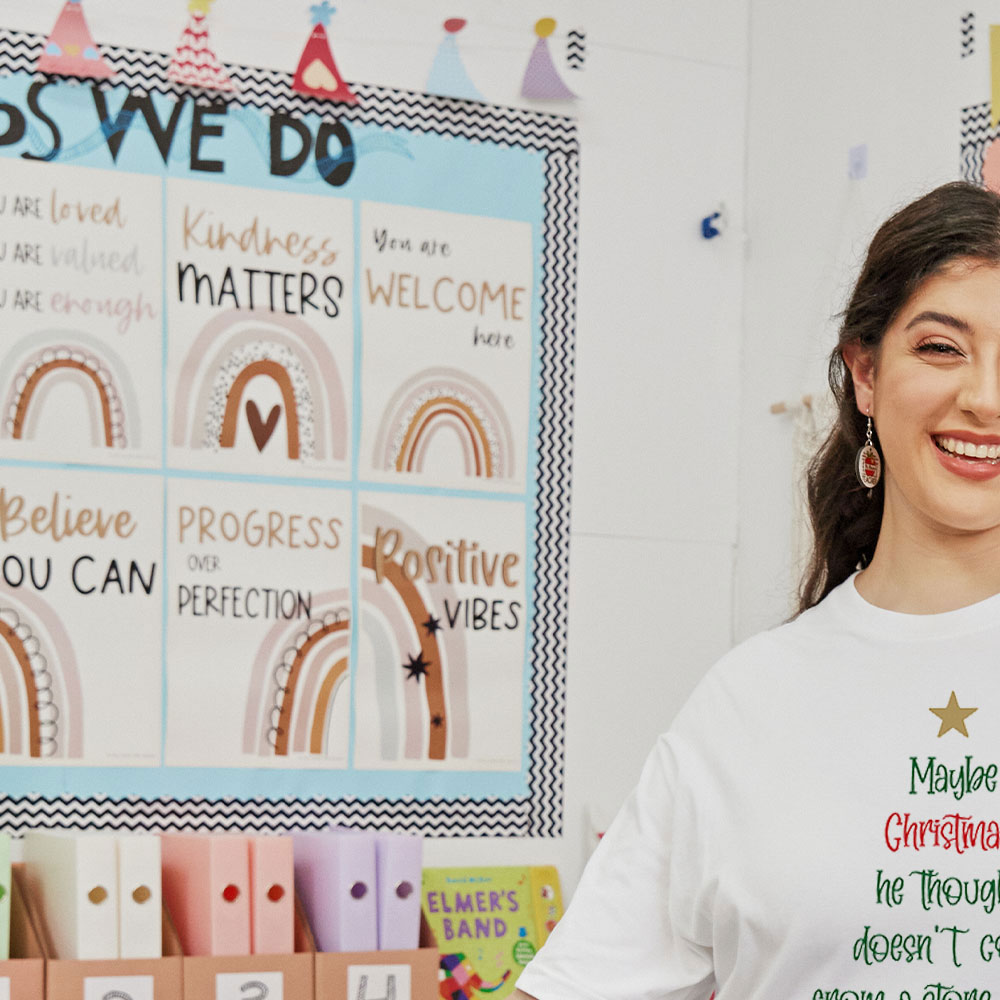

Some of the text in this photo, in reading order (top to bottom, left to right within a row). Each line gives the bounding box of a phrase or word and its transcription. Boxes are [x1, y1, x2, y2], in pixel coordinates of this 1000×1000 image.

[89, 83, 230, 173] WE
[269, 111, 356, 187] DO
[13, 195, 42, 219] ARE
[50, 187, 126, 229] loved
[182, 204, 339, 267] Kindness
[373, 227, 452, 257] You are
[13, 242, 42, 266] ARE
[50, 236, 143, 276] valued
[13, 289, 42, 313] ARE
[50, 290, 157, 336] enough
[366, 270, 526, 321] WELCOME
[472, 325, 516, 350] here
[0, 486, 138, 543] Believe
[179, 505, 343, 549] PROGRESS
[71, 555, 156, 595] CAN
[187, 554, 221, 572] OVER
[374, 526, 521, 588] Positive
[178, 585, 312, 620] PERFECTION
[443, 598, 522, 631] VIBES
[908, 755, 999, 801] Maybe
[427, 890, 519, 913] ELMER'S
[875, 868, 904, 906] he
[443, 918, 507, 941] BAND
